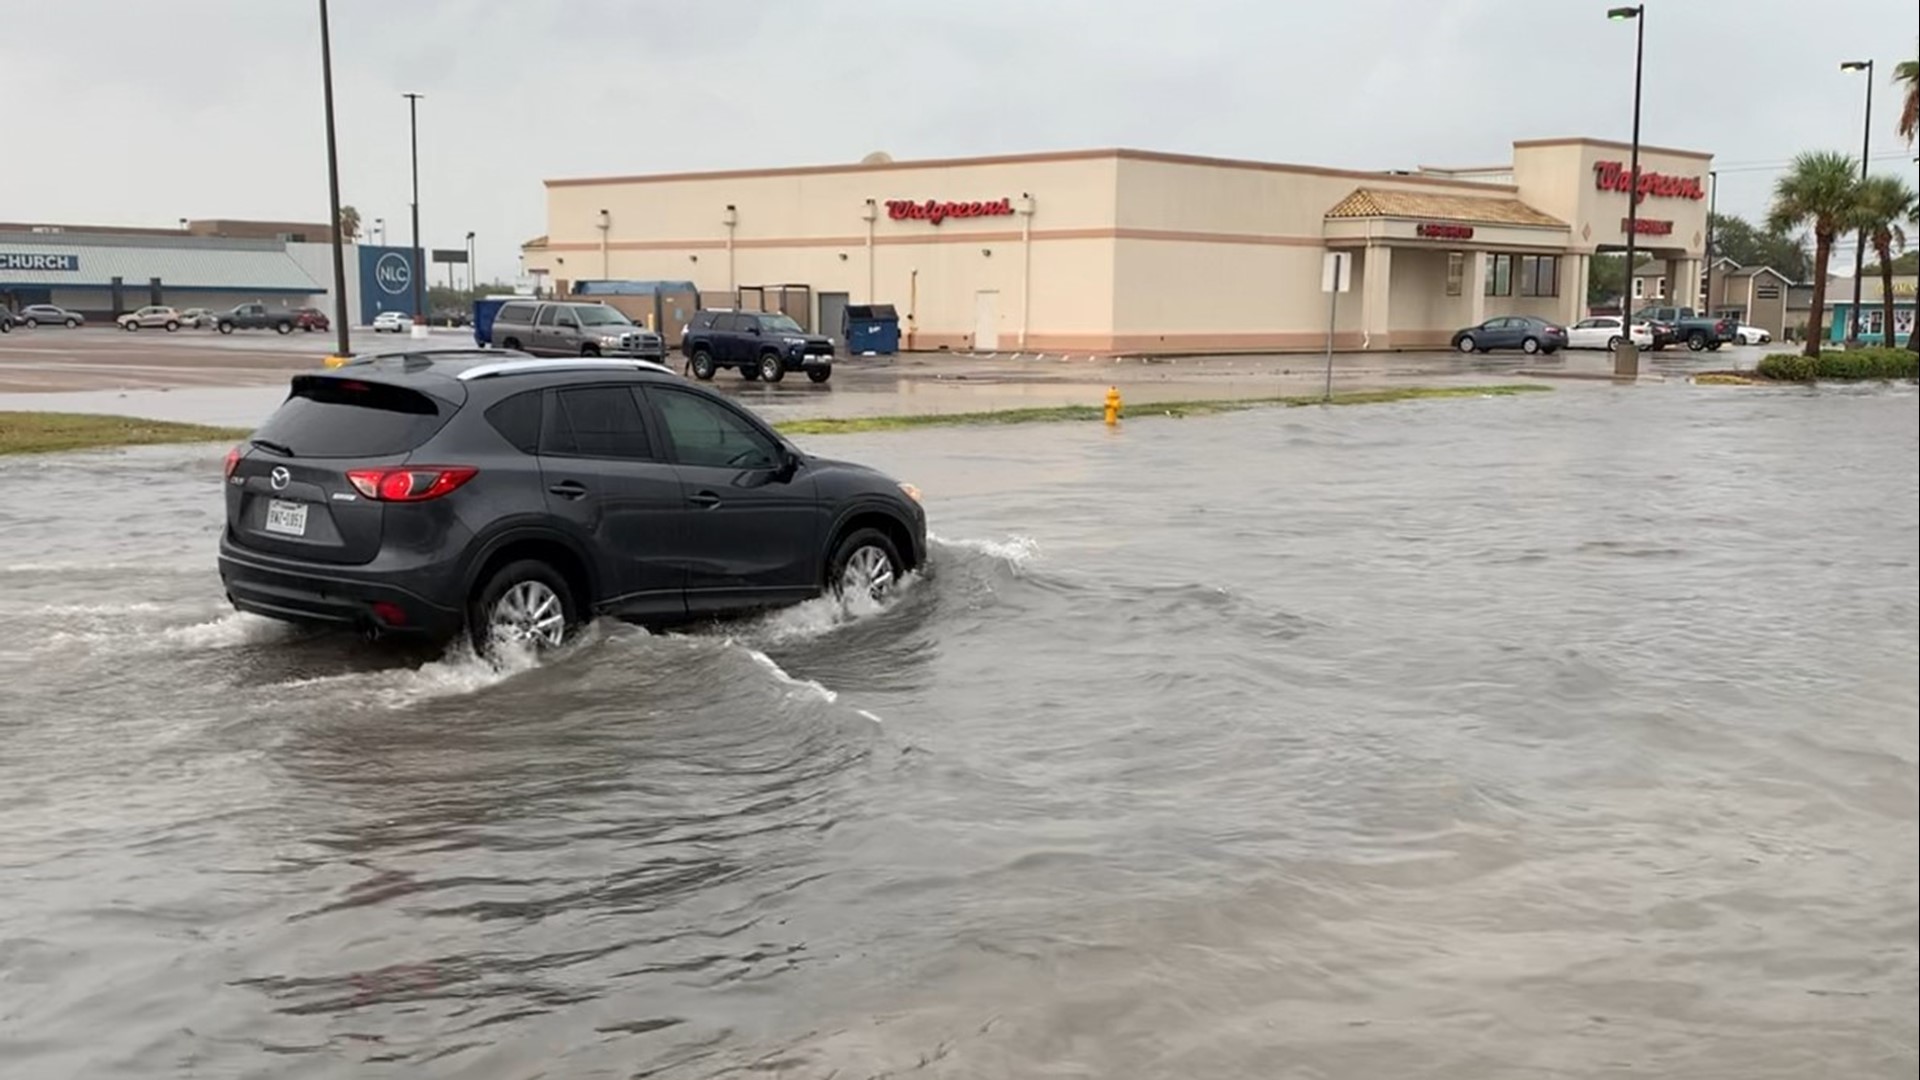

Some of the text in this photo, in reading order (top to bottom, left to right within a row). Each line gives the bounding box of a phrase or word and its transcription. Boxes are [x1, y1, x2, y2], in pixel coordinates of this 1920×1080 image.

[885, 198, 1015, 225] Walgreens
[0, 255, 69, 269] CHURCH
[380, 266, 408, 282] NLC
